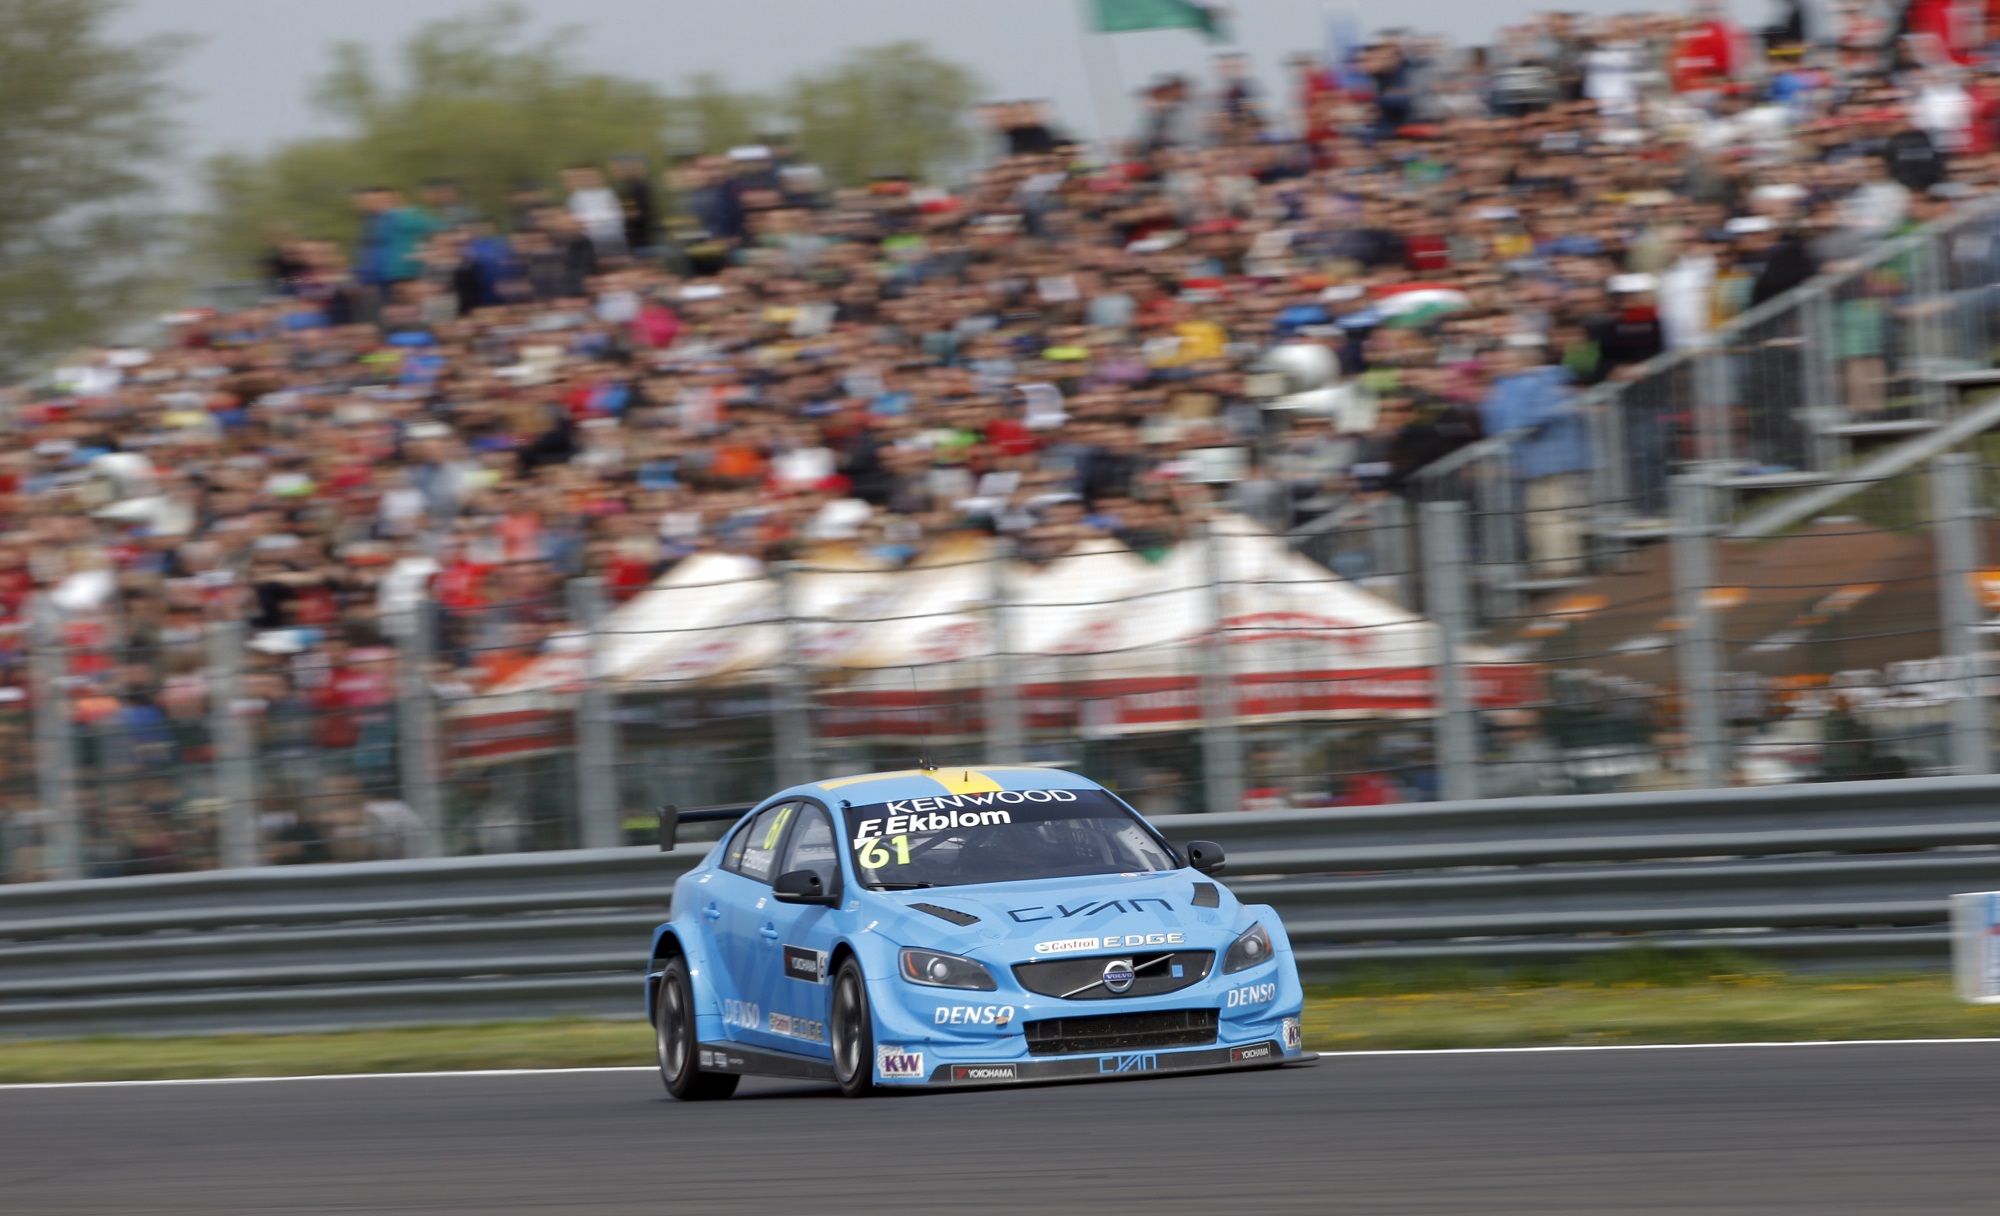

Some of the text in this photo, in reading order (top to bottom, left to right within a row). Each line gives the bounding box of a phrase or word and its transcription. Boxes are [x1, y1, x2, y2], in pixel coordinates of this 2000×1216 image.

[886, 790, 1077, 816] KENWOOD
[857, 809, 1011, 839] F.Ekblom
[859, 834, 911, 869] 61
[1007, 898, 1174, 922] CYAN
[1051, 932, 1185, 950] Castrol EDGE
[1227, 983, 1276, 1008] DENSO
[724, 998, 760, 1030] DENSO
[934, 1005, 1015, 1025] DENSO
[791, 1017, 824, 1043] EDGE
[885, 1054, 920, 1072] KW
[1099, 1053, 1157, 1074] CYAN
[1241, 1047, 1269, 1059] YOKOHAMA
[967, 1069, 1014, 1079] YOKOHAMA
